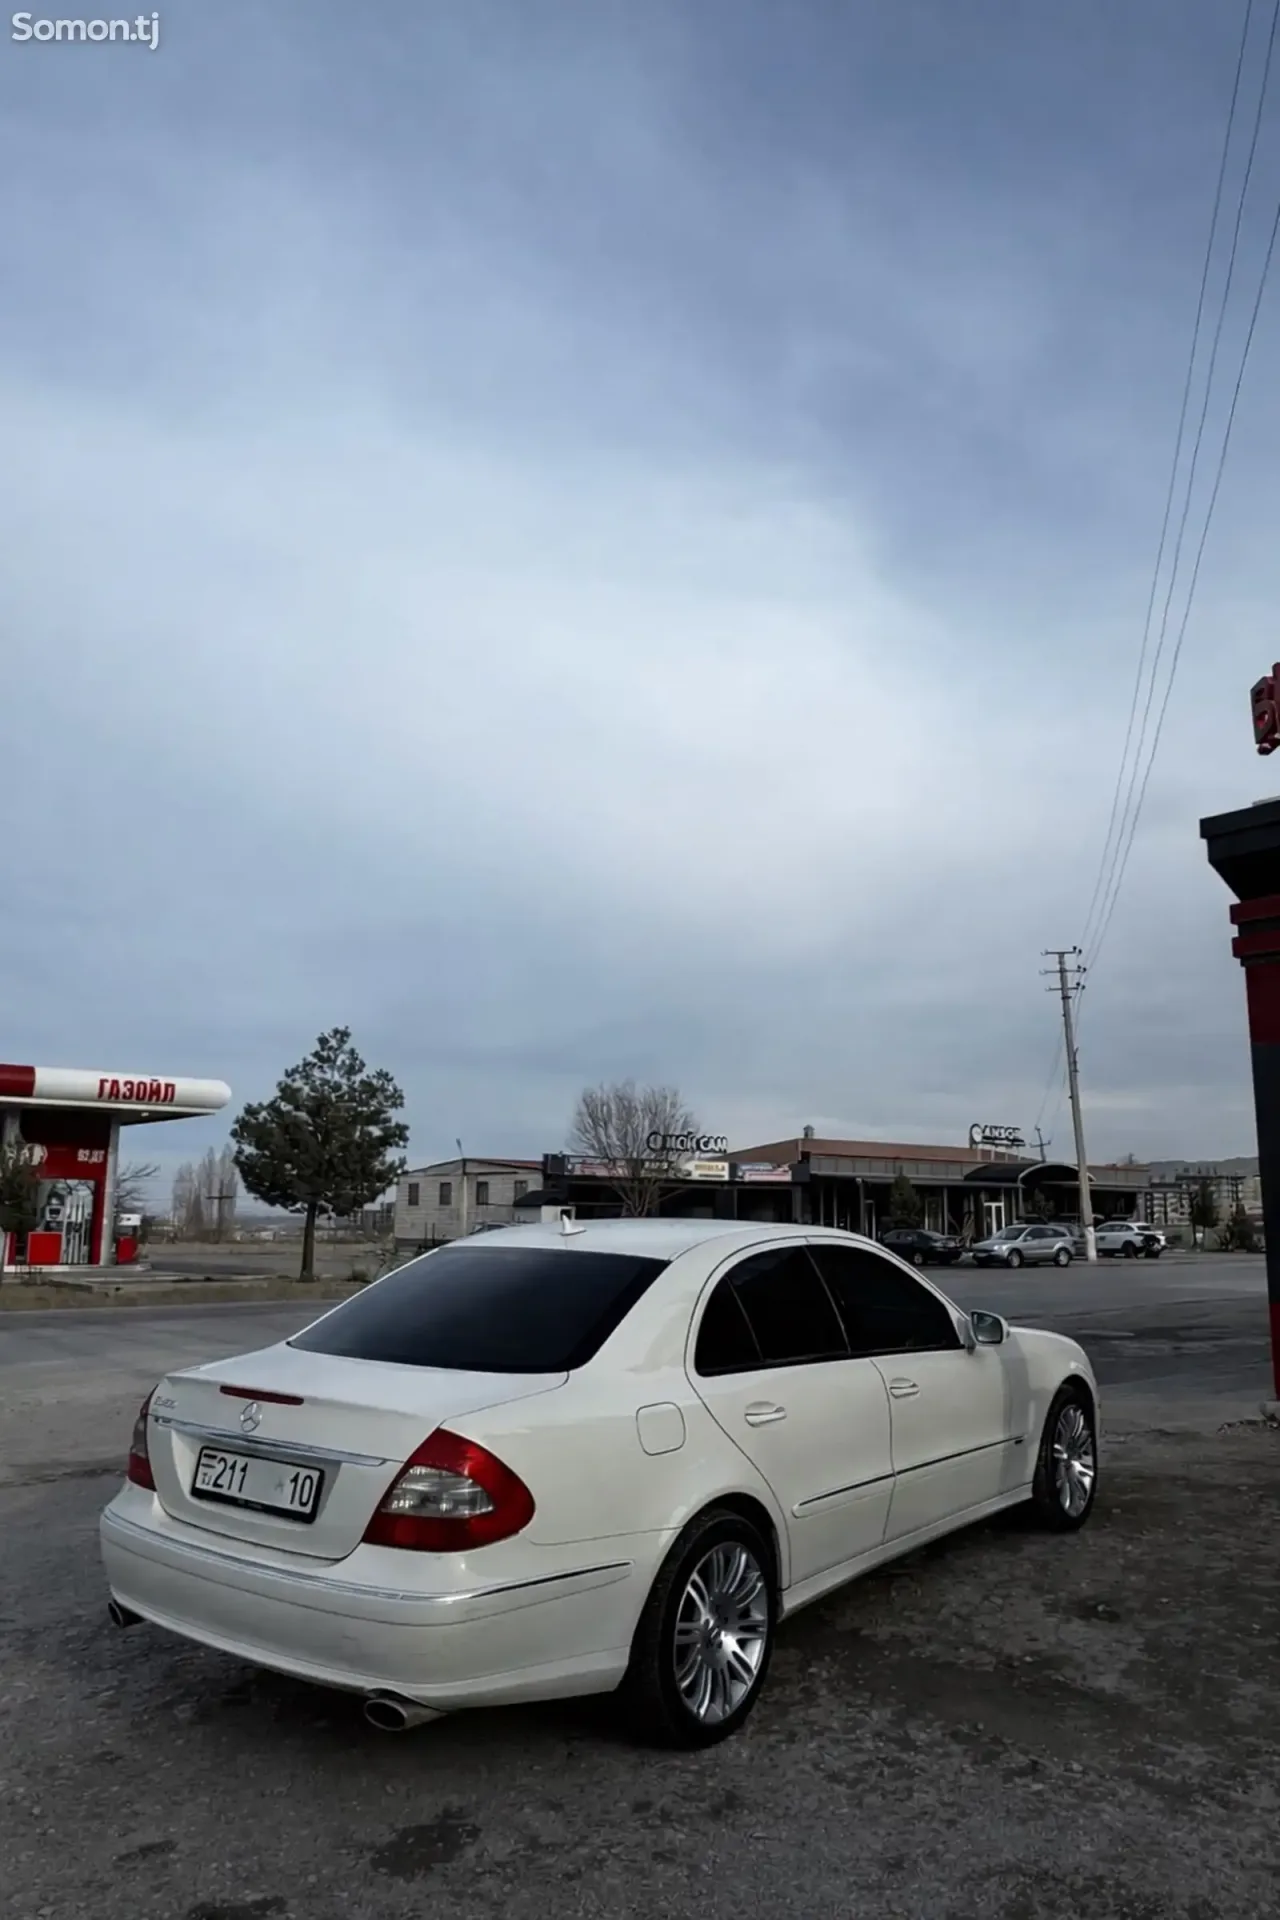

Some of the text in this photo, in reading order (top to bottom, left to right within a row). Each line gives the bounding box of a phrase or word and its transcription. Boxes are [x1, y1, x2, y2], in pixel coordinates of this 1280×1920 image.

[97, 1078, 176, 1103] ГАЗОЙЛ
[212, 1457, 248, 1493] 211
[289, 1471, 314, 1507] 10
